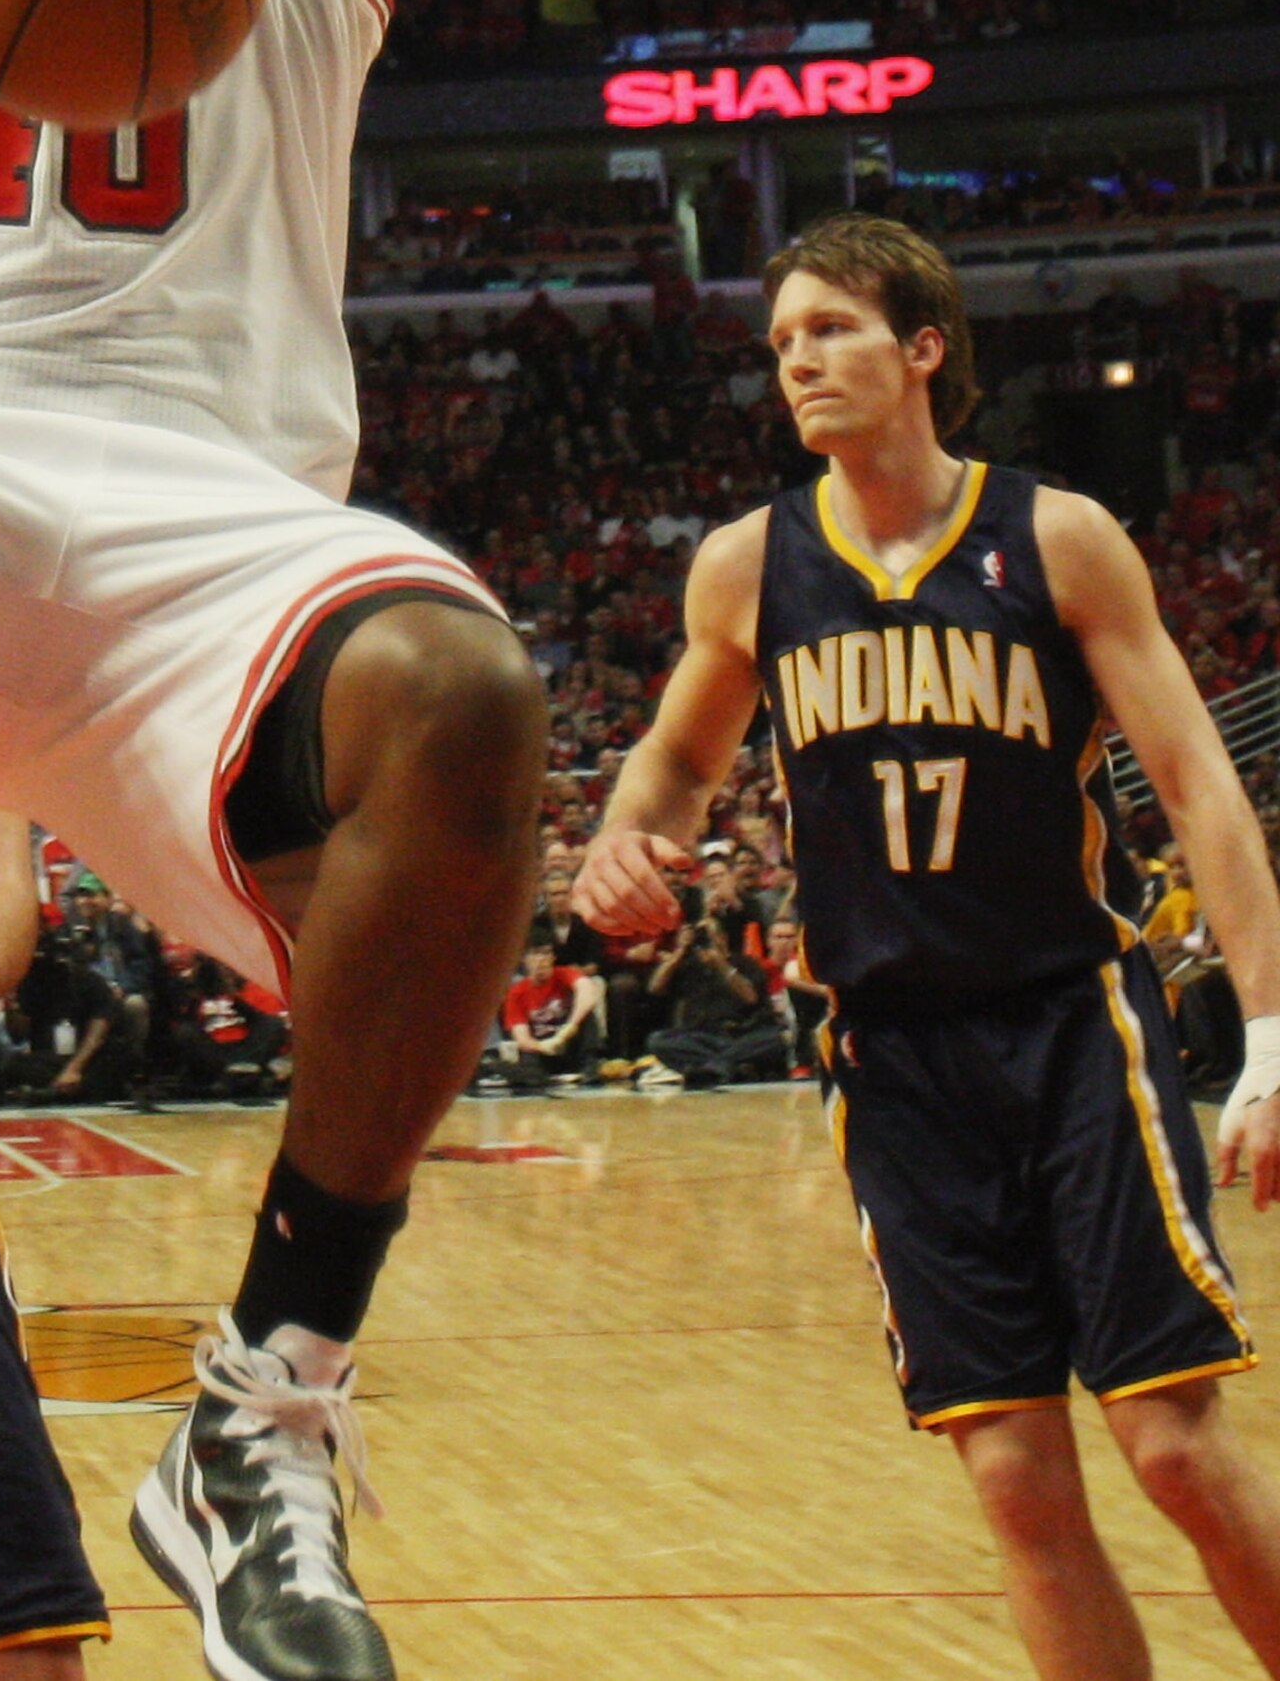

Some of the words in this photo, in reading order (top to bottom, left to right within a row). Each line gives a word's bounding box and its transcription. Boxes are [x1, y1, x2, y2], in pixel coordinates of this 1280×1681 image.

[603, 56, 935, 128] SHARP
[777, 624, 1051, 752] INDIANA
[872, 756, 967, 873] 17
